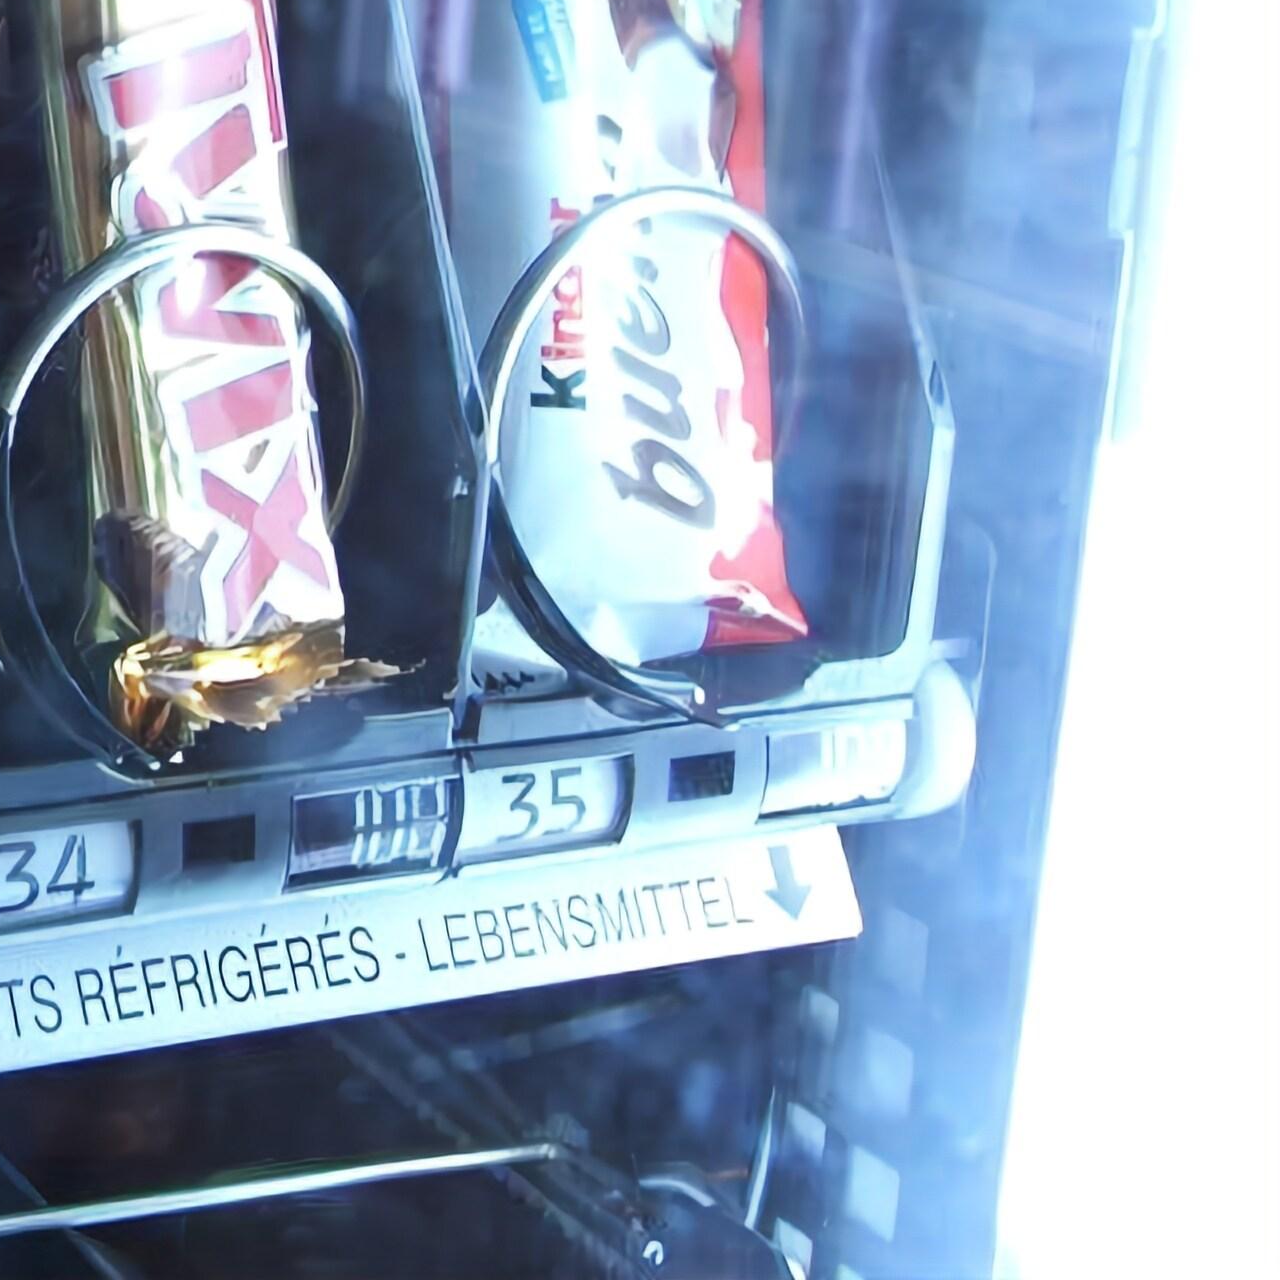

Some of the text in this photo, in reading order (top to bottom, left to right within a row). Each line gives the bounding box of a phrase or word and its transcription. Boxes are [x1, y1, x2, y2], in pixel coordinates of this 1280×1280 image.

[498, 766, 586, 841] 35
[74, 913, 381, 1027] RÉFRIGÉRÉS
[419, 876, 754, 973] LEBENSMITTEL
